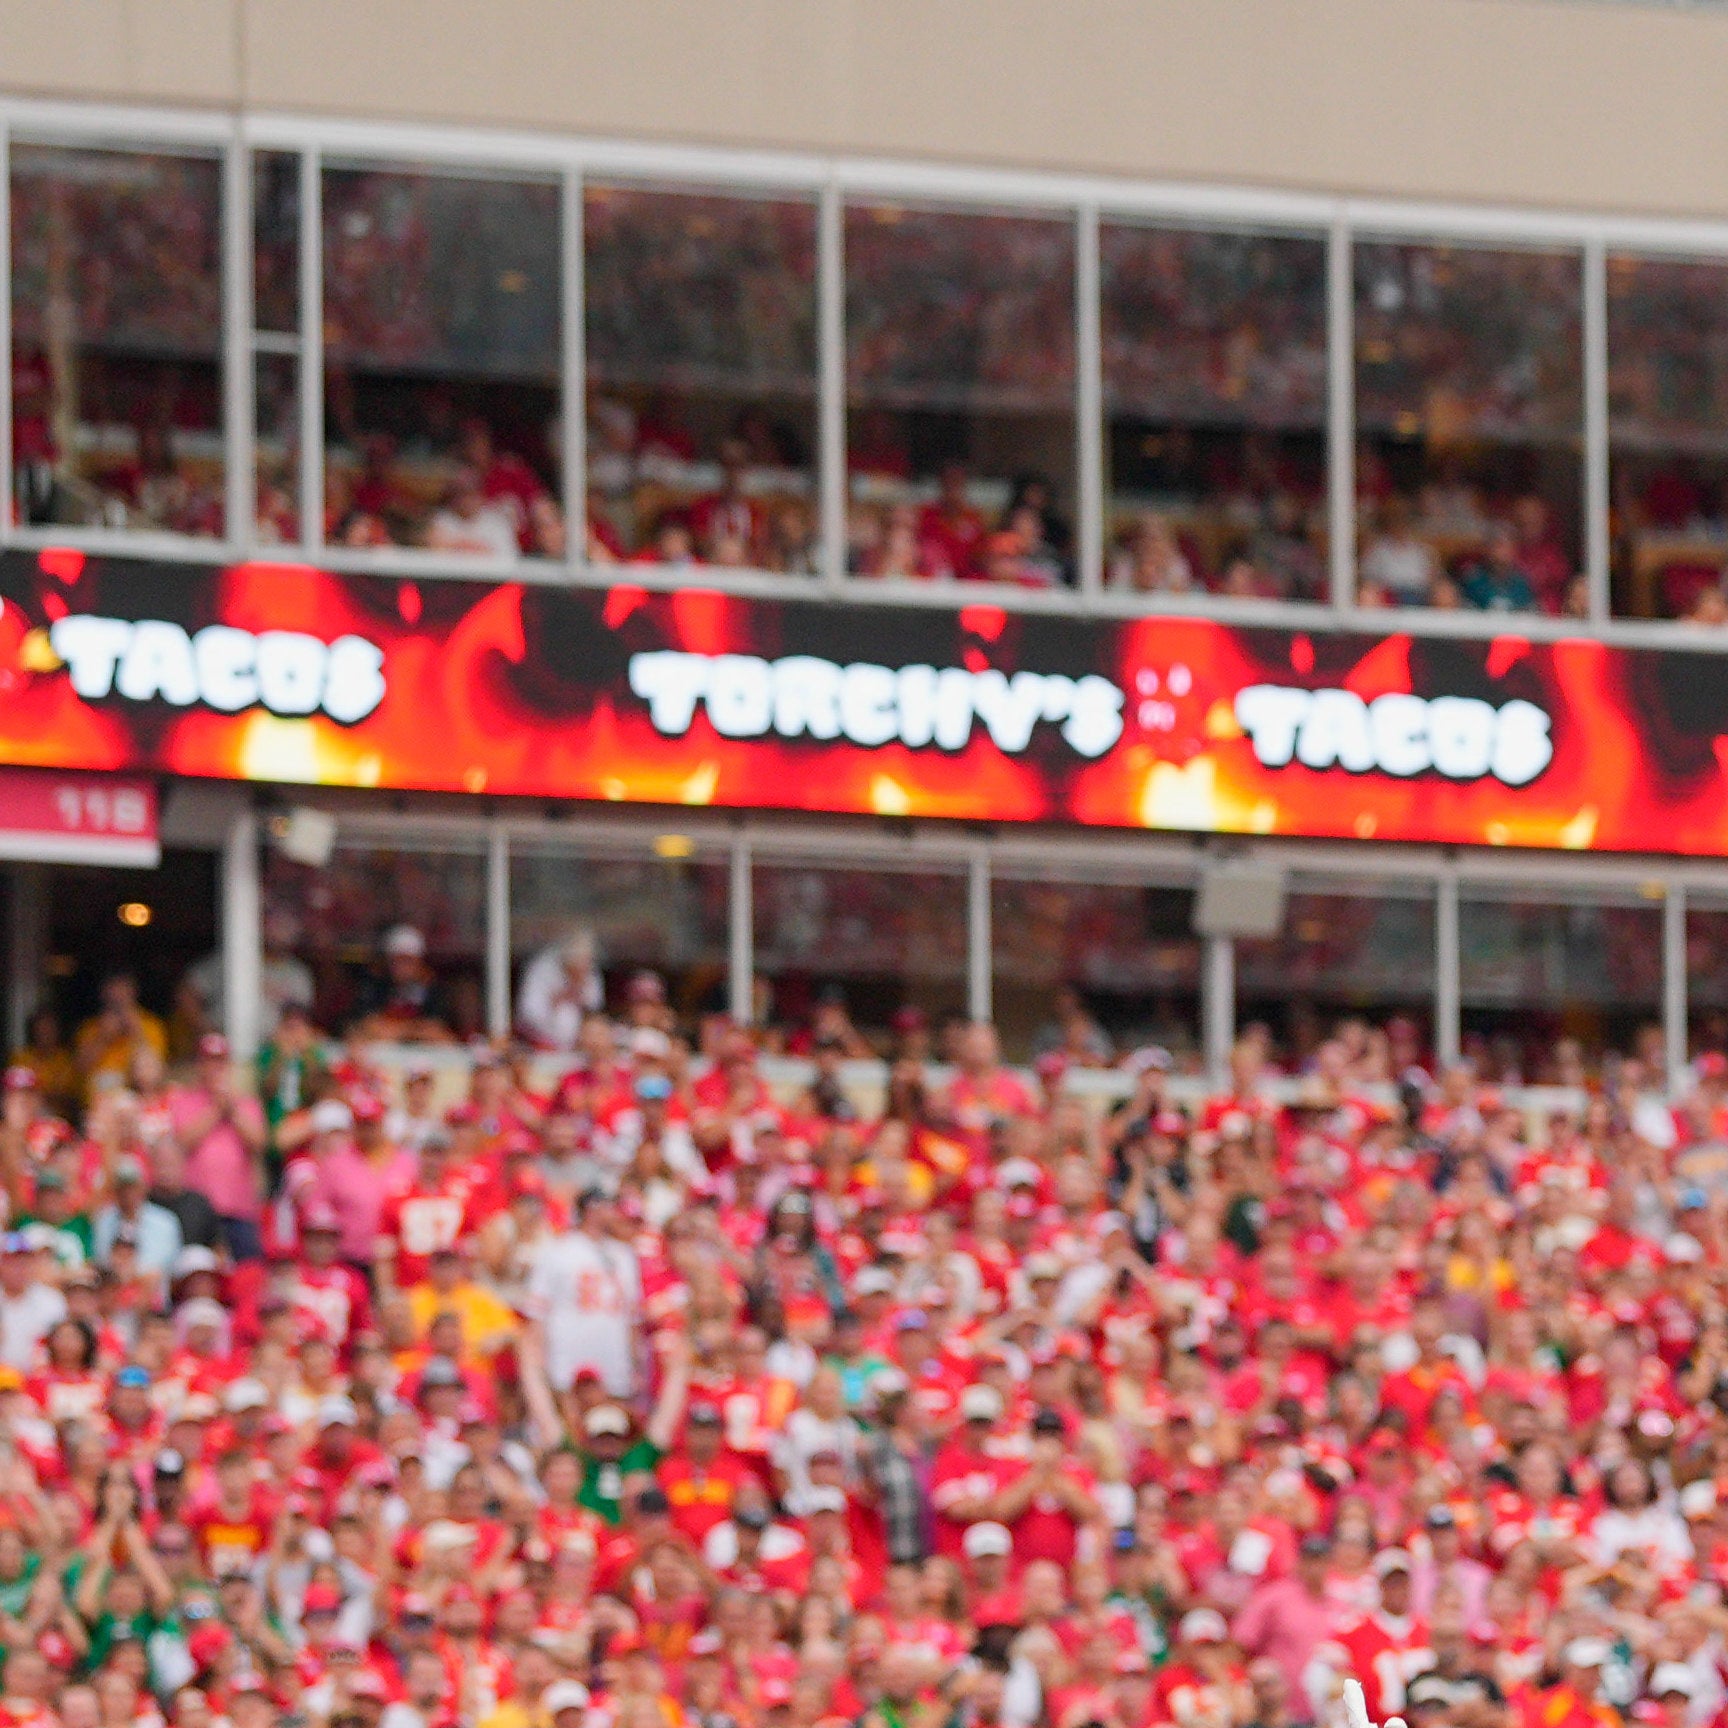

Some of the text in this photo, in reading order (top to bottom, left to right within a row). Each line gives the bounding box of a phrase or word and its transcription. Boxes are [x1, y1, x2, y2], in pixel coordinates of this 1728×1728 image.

[48, 610, 388, 728] TACOS
[626, 646, 1555, 786] TORCHY'S TACOS
